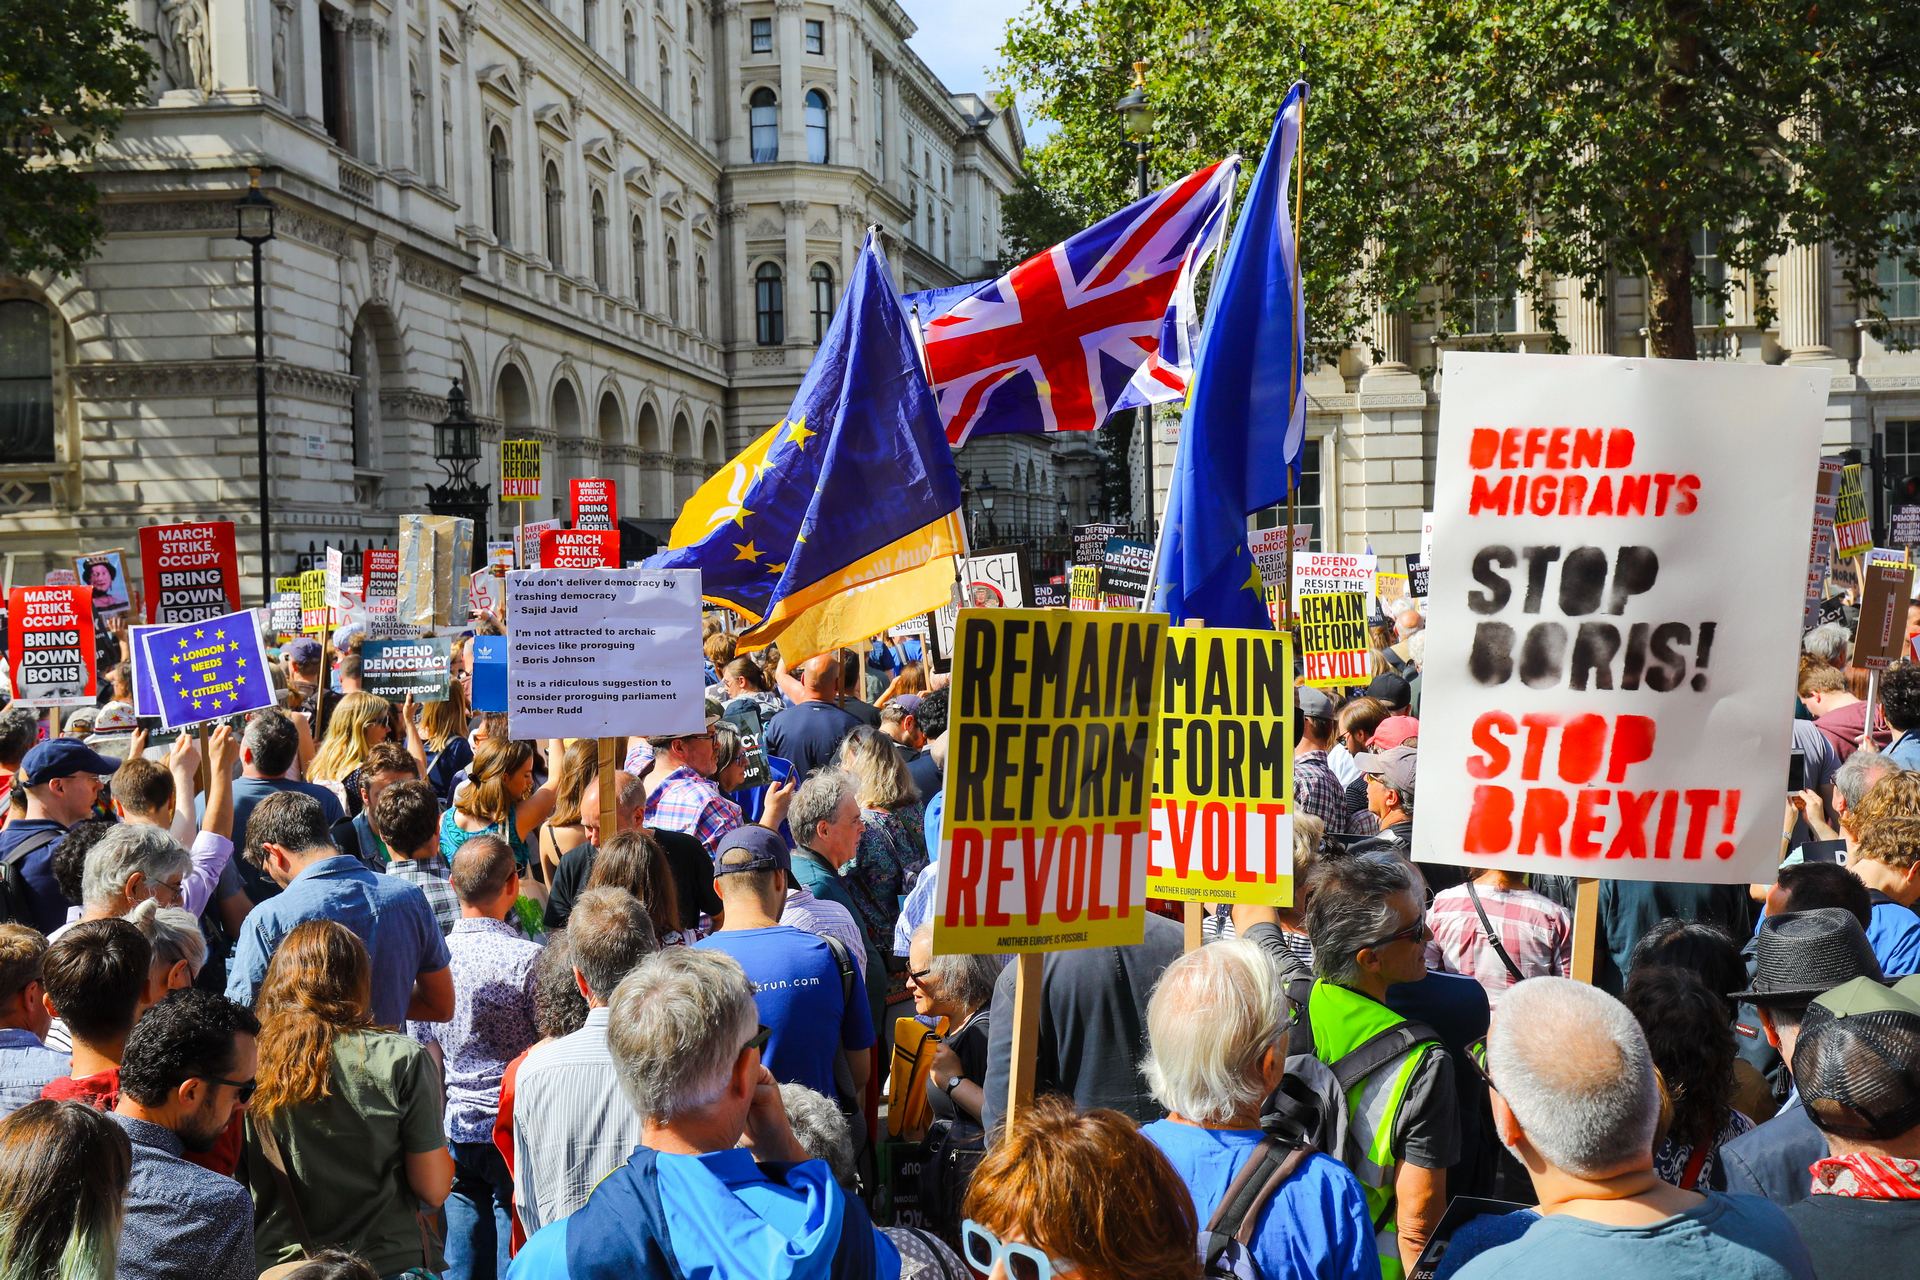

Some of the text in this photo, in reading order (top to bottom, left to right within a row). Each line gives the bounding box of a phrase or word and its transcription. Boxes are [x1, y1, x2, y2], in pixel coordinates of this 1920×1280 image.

[503, 443, 540, 460] REMAIN
[1468, 427, 1636, 469] DEFEND
[503, 460, 540, 478] REFORM
[503, 478, 540, 496] REVOLT
[1841, 466, 1862, 495] MAIN
[1468, 474, 1701, 517] MIGRANTS
[579, 504, 608, 513] BRING
[580, 514, 609, 522] DOWN
[158, 527, 216, 541] MARCH,
[555, 534, 604, 545] MARCH,
[1837, 518, 1870, 551] REVOLT
[162, 541, 214, 554] STRIKE,
[558, 546, 602, 556] STRIKE,
[158, 552, 220, 567] OCCUPY
[554, 557, 605, 567] OCCUPY
[1258, 552, 1284, 564] RESIST
[1312, 556, 1357, 566] DEFEND
[161, 570, 221, 587] BRING
[1296, 567, 1372, 578] DEMOCRACY
[515, 578, 676, 589] You don't deliver democracy by
[1304, 579, 1364, 590] RESIST THE
[1468, 545, 1659, 617] STOP
[24, 590, 74, 602] MARCH,
[162, 588, 223, 605] DOWN
[371, 588, 396, 596] BORIS
[514, 592, 617, 602] trashing democracy
[1034, 587, 1053, 596] END
[1035, 595, 1067, 605] CRACY
[26, 602, 73, 615] STRIKE,
[166, 607, 222, 623] BORIS
[521, 606, 547, 615] Sajid
[550, 605, 578, 614] Javid
[1301, 594, 1364, 624] REMAIN
[22, 615, 78, 628] OCCUPY
[1883, 602, 1894, 643] FRAGILE
[24, 631, 79, 647] BRING
[515, 628, 656, 637] I'm not attracted to archaic
[1304, 622, 1366, 651] REFORM
[183, 644, 225, 661] LONDON
[382, 645, 433, 658] DEFEND
[515, 641, 635, 651] devices like proroguing
[24, 649, 80, 665] DOWN
[364, 656, 449, 670] DEMOCRACY
[522, 656, 549, 664] Boris
[552, 655, 595, 664] Johnson
[1469, 621, 1717, 692] BORIS!
[191, 658, 223, 672] NEEDS
[961, 619, 1160, 718] REMAIN
[1306, 650, 1367, 680] REVOLT
[27, 667, 78, 683] BORIS
[202, 672, 217, 683] EU
[1164, 636, 1284, 717] MAIN
[192, 681, 234, 698] CITIZENS
[372, 684, 441, 695] #STOPTHECOUP
[549, 679, 599, 687] ridiculous
[602, 679, 658, 688] suggestion
[661, 679, 671, 687] to
[516, 692, 677, 702] consider proroguing parliament
[516, 706, 583, 714] -Amber Rudd
[1466, 709, 1656, 784] STOP
[953, 721, 1149, 822] REFORM
[1463, 785, 1741, 861] BREXIT!
[944, 820, 1142, 928] REVOLT
[1154, 885, 1236, 898] ANOTHER EUROPE IS POSSIBLE
[996, 932, 1088, 947] ANOTHER EUROPE IS POSSIBLE
